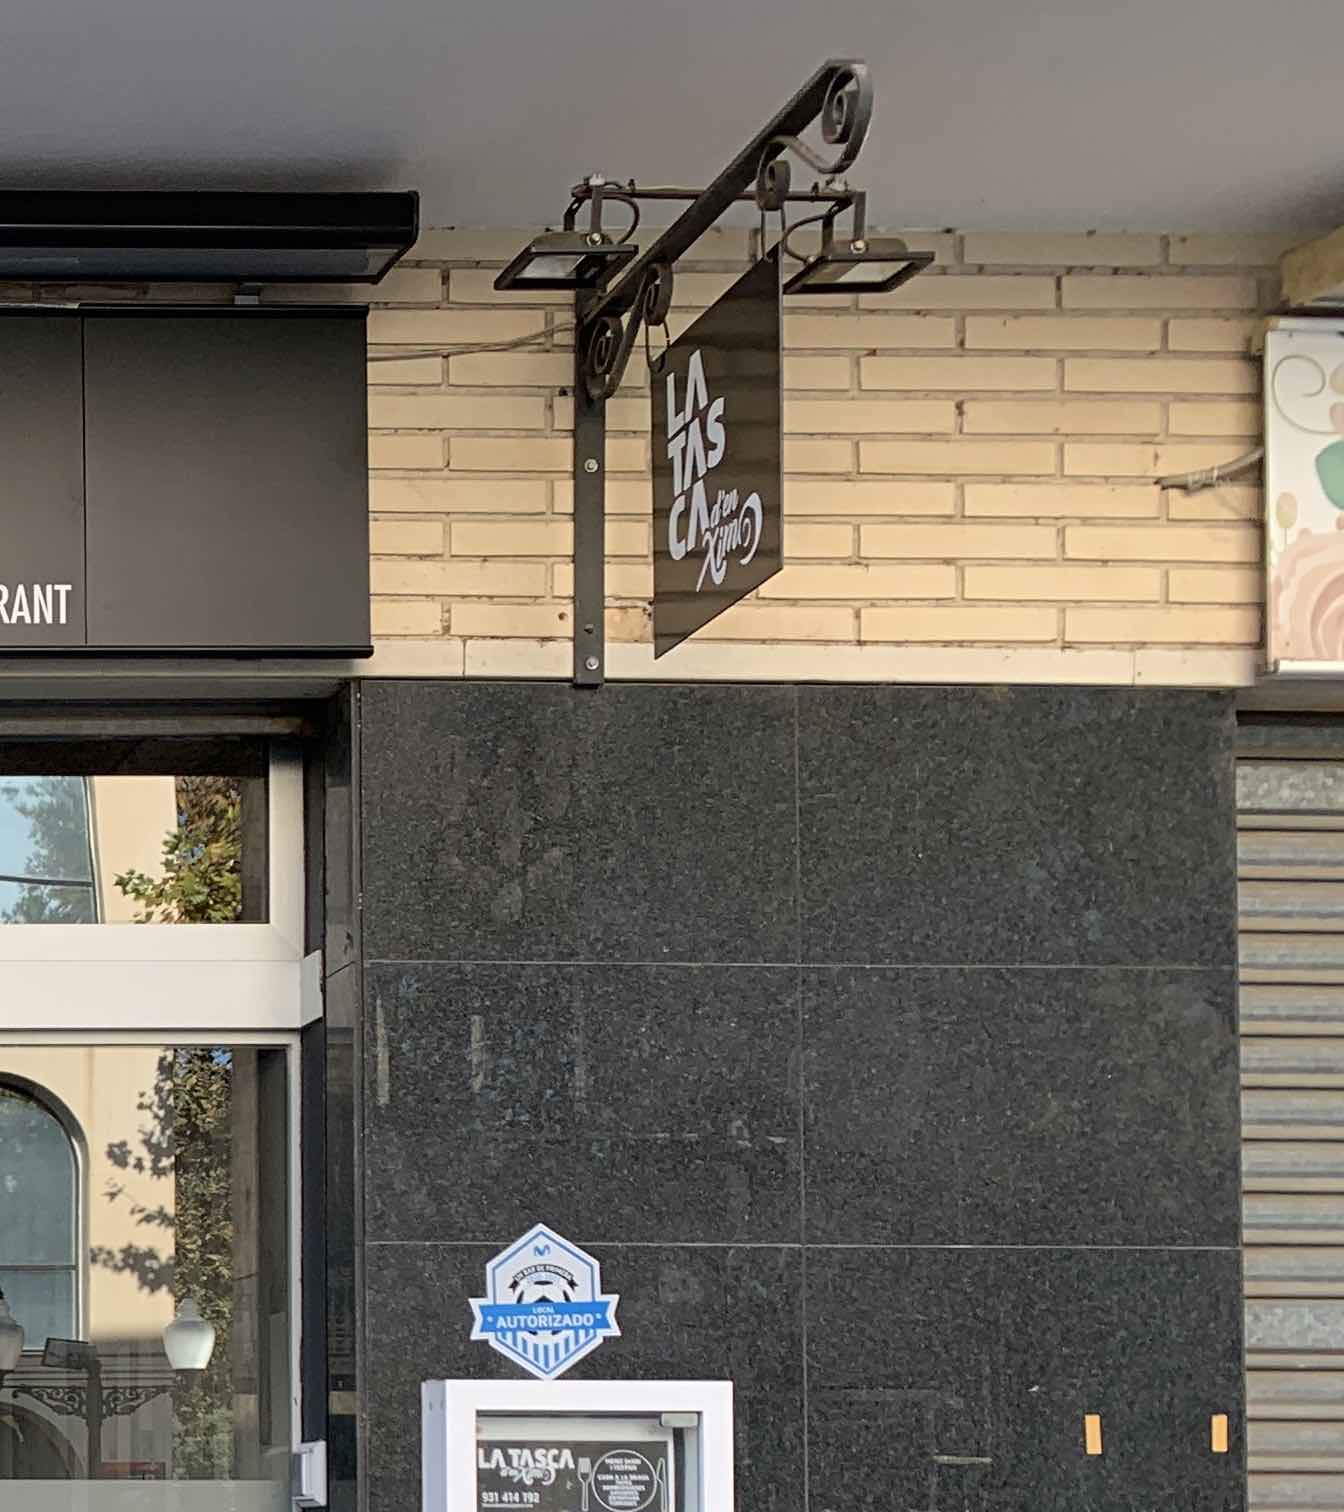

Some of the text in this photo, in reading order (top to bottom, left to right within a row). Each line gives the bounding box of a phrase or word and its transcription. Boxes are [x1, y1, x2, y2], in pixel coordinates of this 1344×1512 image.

[666, 348, 708, 438] LA
[667, 397, 725, 497] TAS
[668, 479, 711, 560] CA
[496, 1313, 595, 1330] AUTORIZADO
[478, 1447, 576, 1470] LA TASCA
